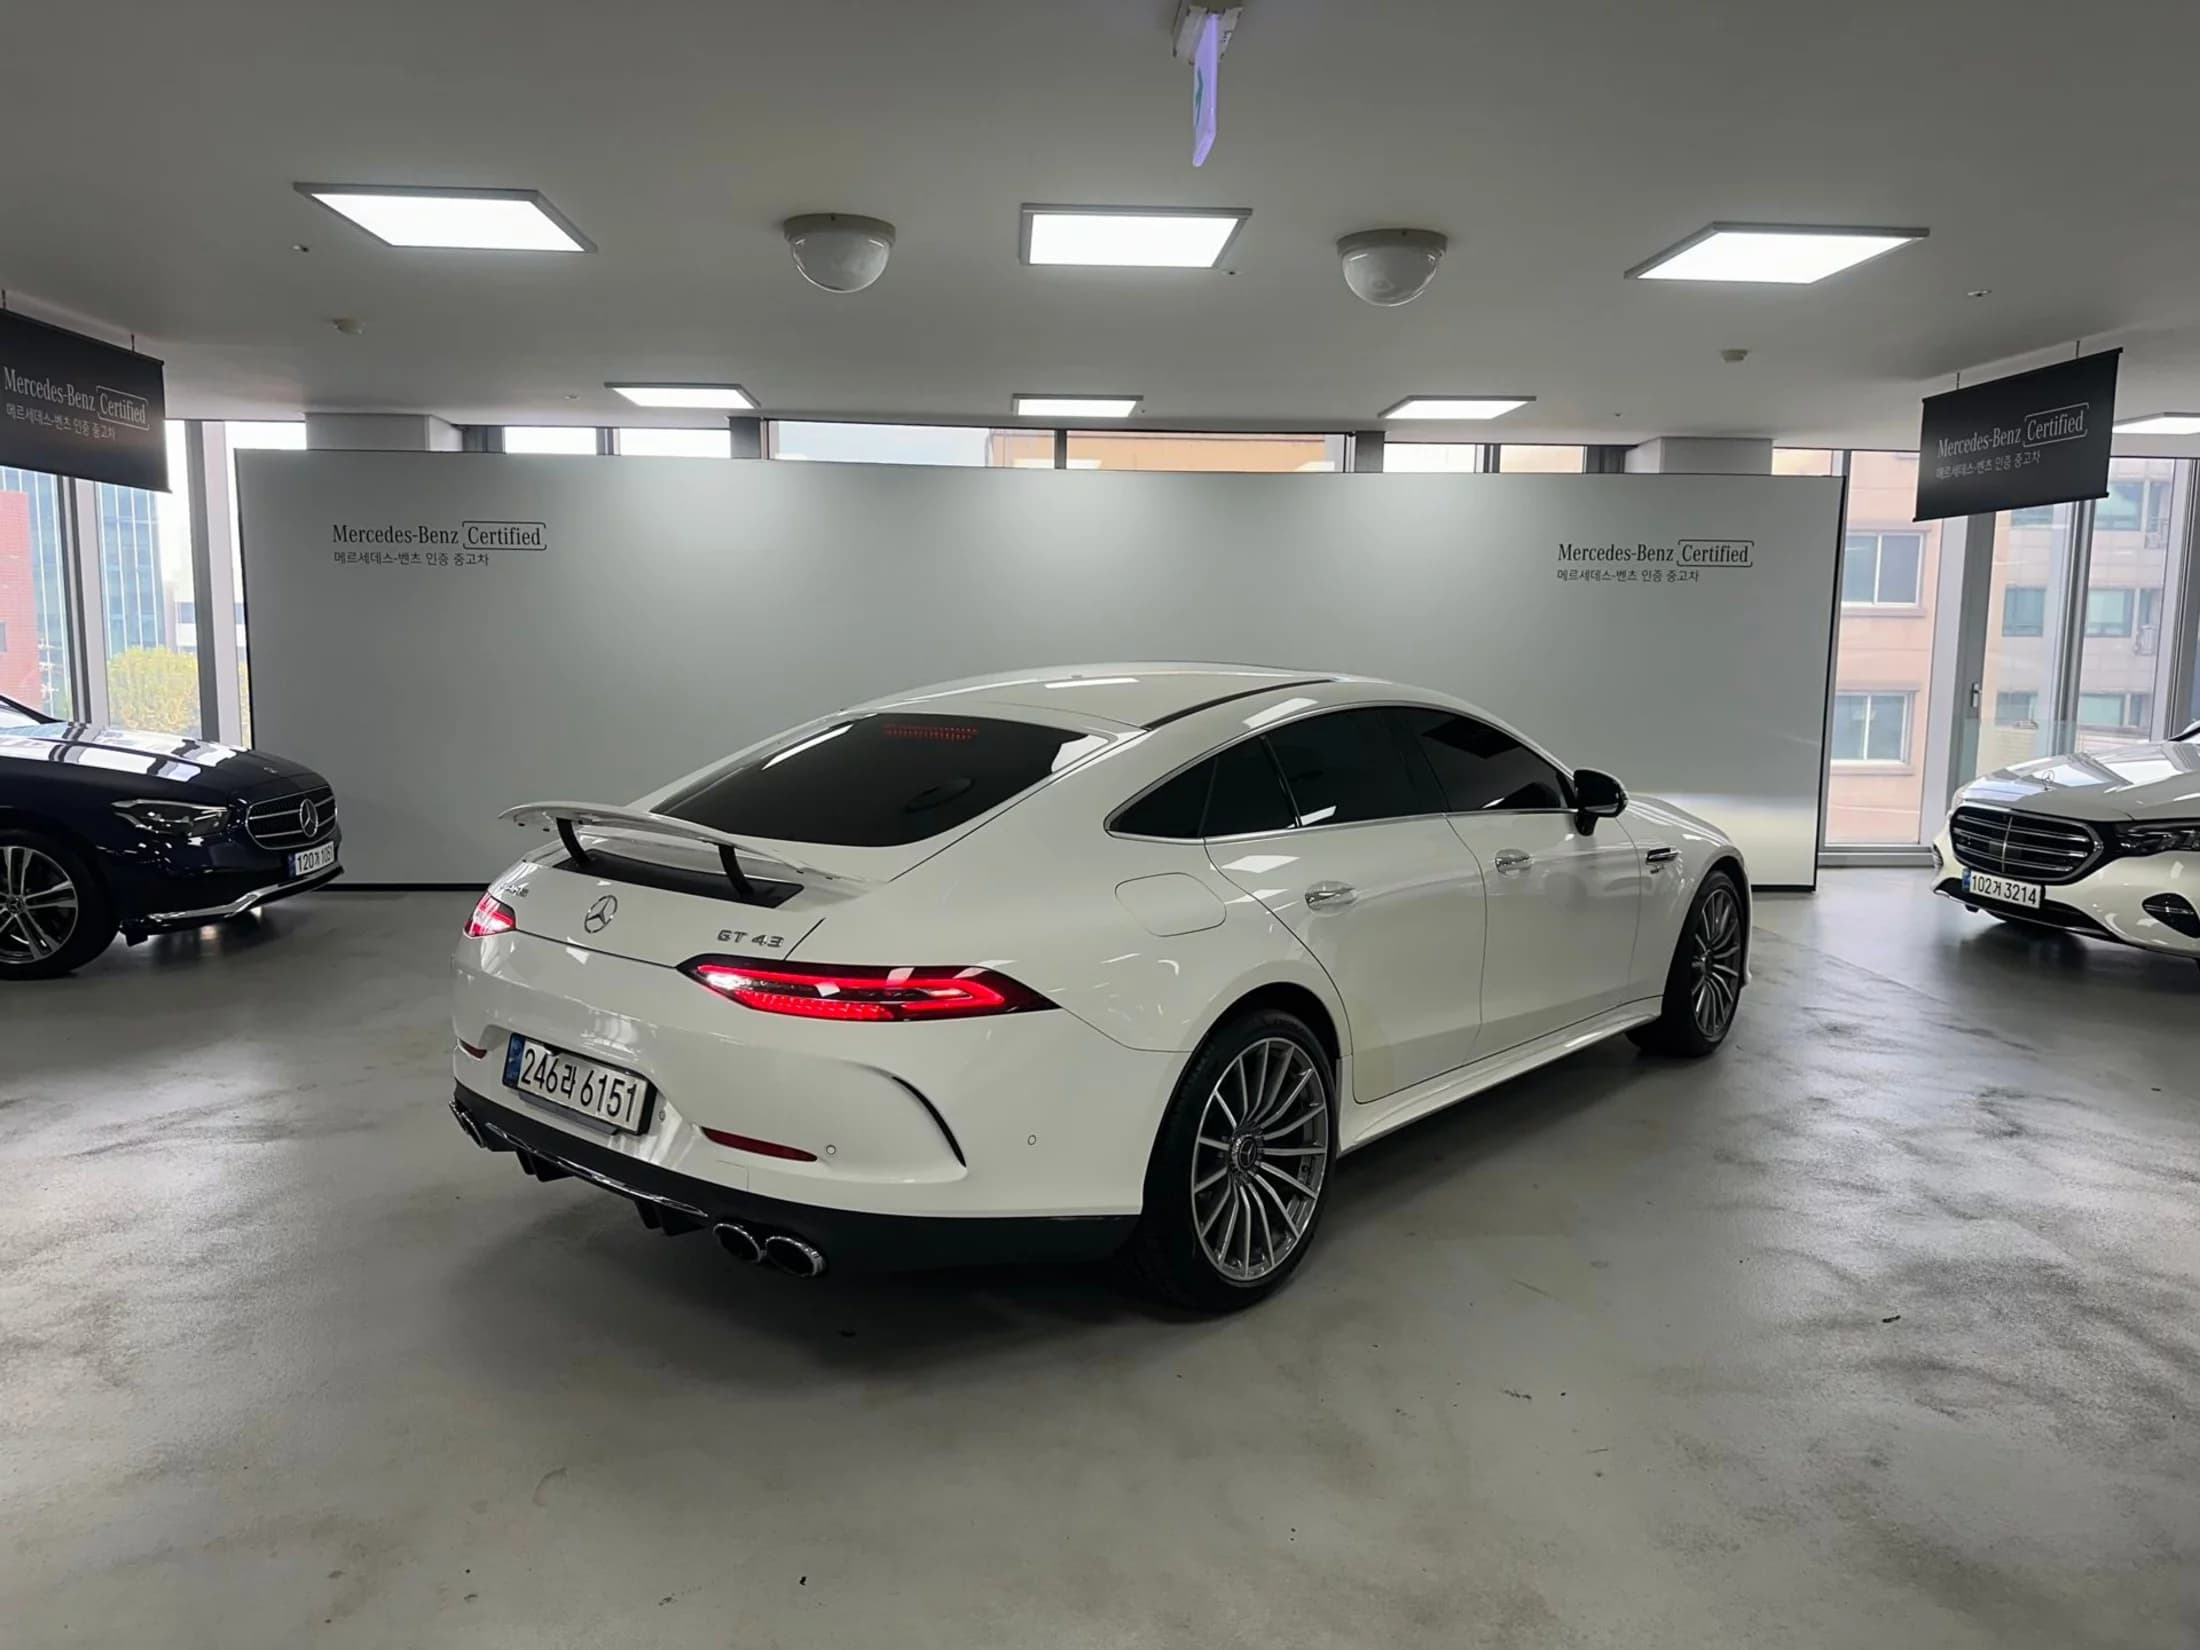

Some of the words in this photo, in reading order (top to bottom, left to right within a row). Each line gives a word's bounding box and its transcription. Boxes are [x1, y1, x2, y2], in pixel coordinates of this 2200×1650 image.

[3, 366, 96, 413] Mercedes-Benz
[100, 391, 146, 425] Certified
[6, 402, 73, 431] 메르세데스-벤츠
[73, 417, 91, 437] 인증
[92, 424, 116, 441] 중고차
[1937, 427, 2022, 459] Mercedes-Benz
[2027, 410, 2084, 441] Certified
[1995, 454, 2013, 472] 인증
[2014, 450, 2041, 469] 중고차
[332, 524, 459, 545] Mercedes-Benz
[467, 526, 541, 546] Certified
[334, 551, 422, 566] 메르세데스-벤츠
[425, 552, 449, 567] 인증
[453, 552, 489, 567] 중고차
[1557, 543, 1674, 562] Mercedes-Benz
[1681, 543, 1749, 563] Certified
[1556, 568, 1638, 583] 메르세데스-벤츠
[1641, 569, 1664, 583] 인증
[1666, 569, 1700, 583] 중고차
[2003, 882, 2038, 905] 3214
[717, 929, 748, 944] GT
[751, 934, 785, 948] 43
[520, 1048, 577, 1100] 246라
[580, 1069, 638, 1123] 6151
